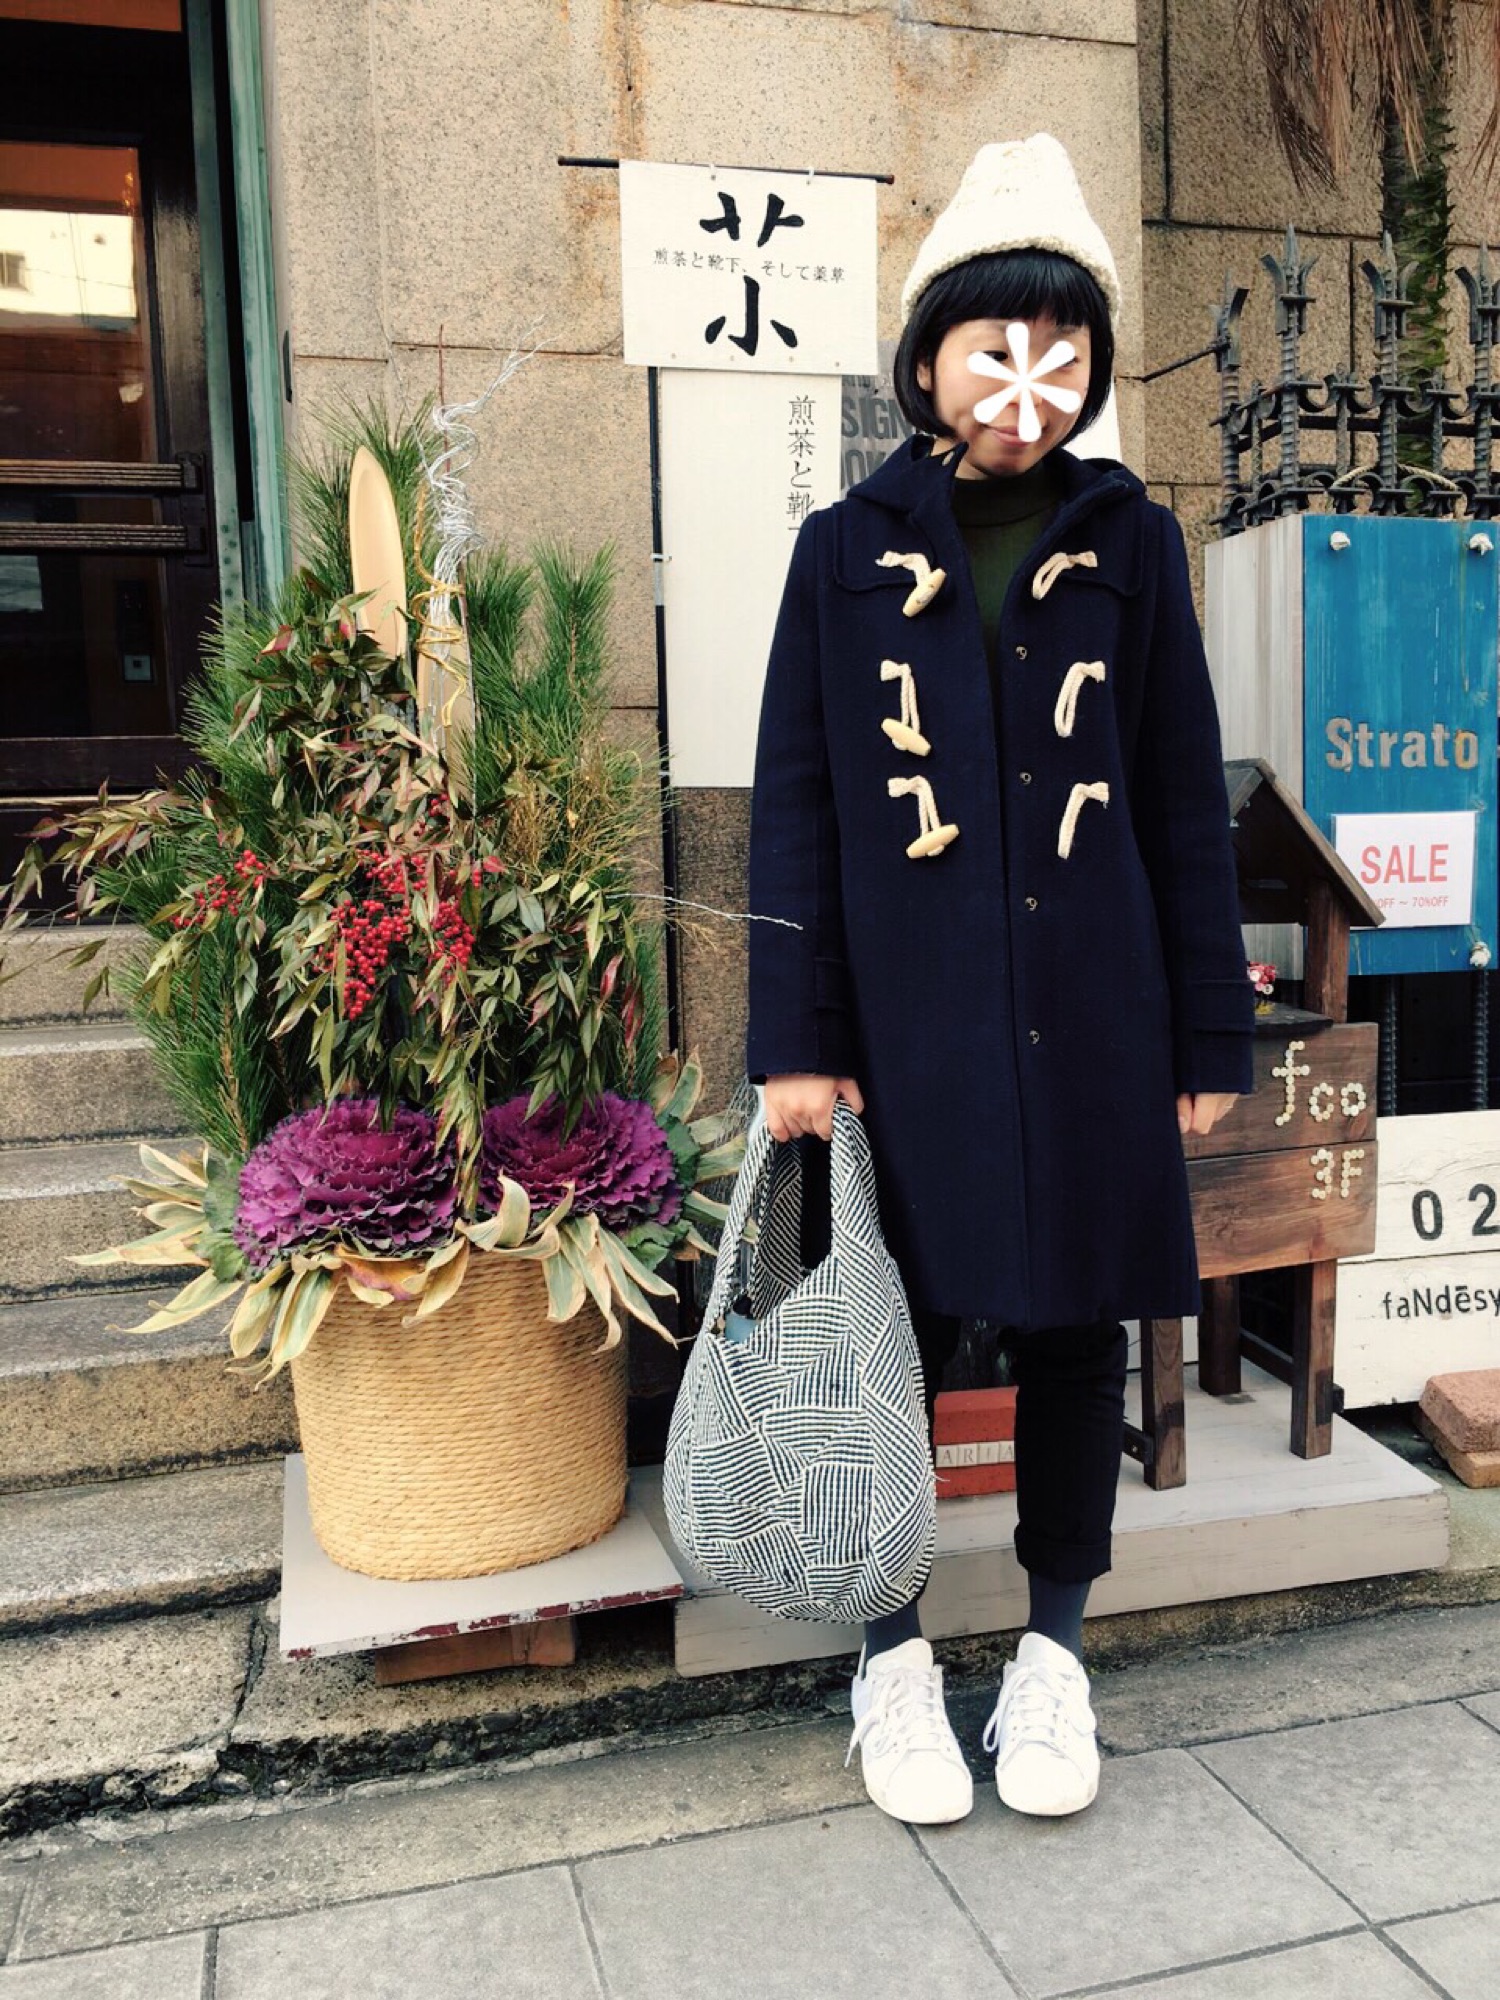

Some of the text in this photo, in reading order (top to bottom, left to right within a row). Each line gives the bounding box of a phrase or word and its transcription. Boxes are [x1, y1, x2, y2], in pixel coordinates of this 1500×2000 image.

[1325, 716, 1479, 772] Strato
[1360, 844, 1449, 884] SALE
[1310, 1148, 1364, 1200] 3F
